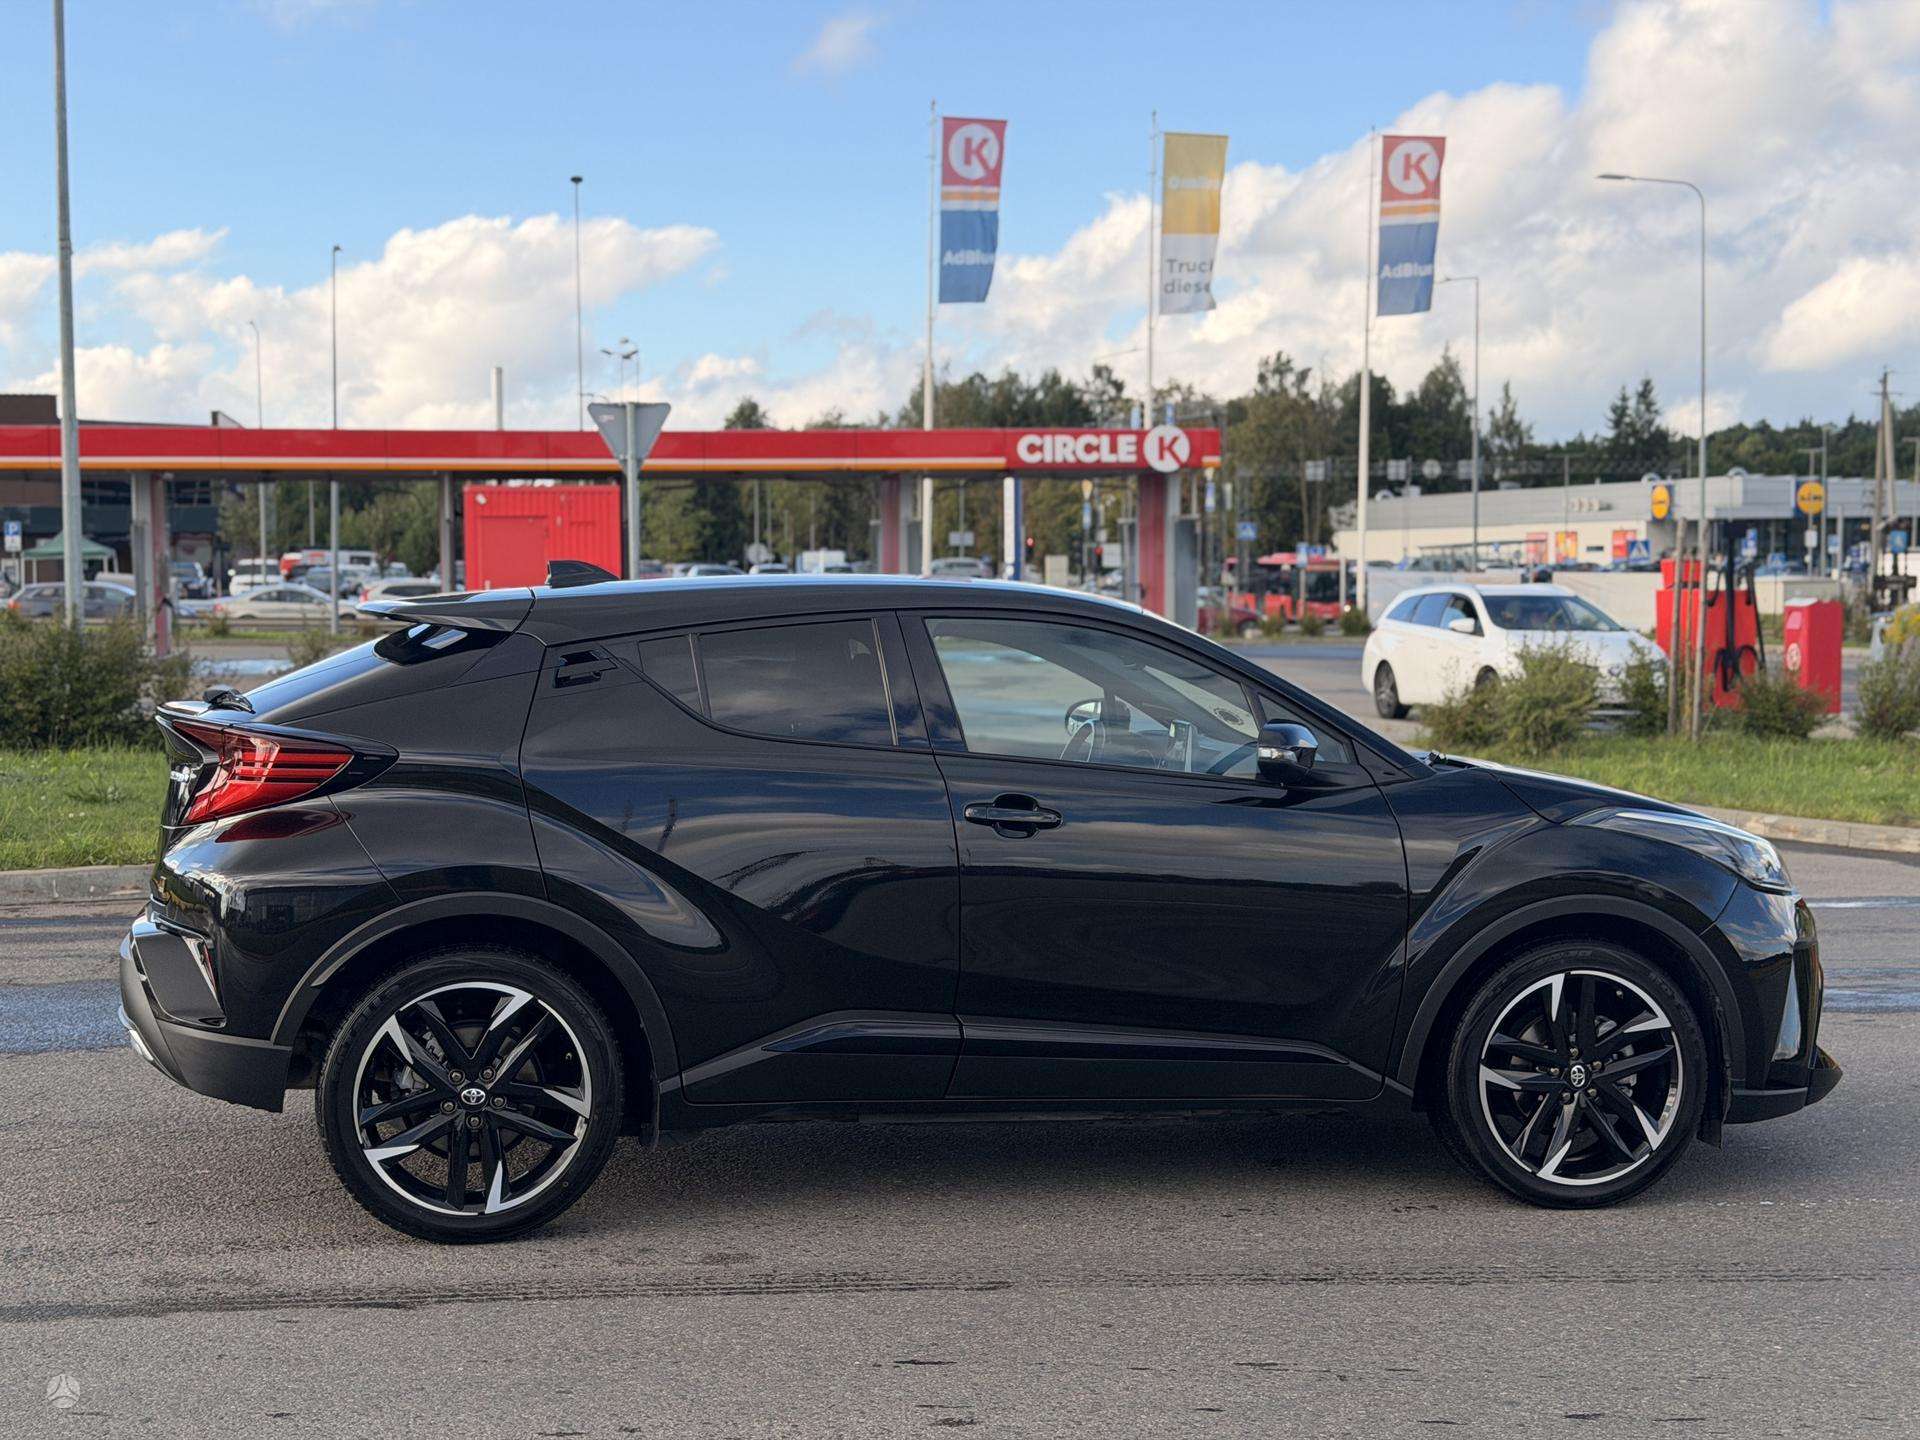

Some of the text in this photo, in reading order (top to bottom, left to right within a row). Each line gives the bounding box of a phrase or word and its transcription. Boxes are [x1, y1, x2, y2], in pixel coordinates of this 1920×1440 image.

[943, 249, 995, 265] AdBlu
[1380, 261, 1433, 279] AdBlu
[1017, 434, 1138, 463] CIRCLE
